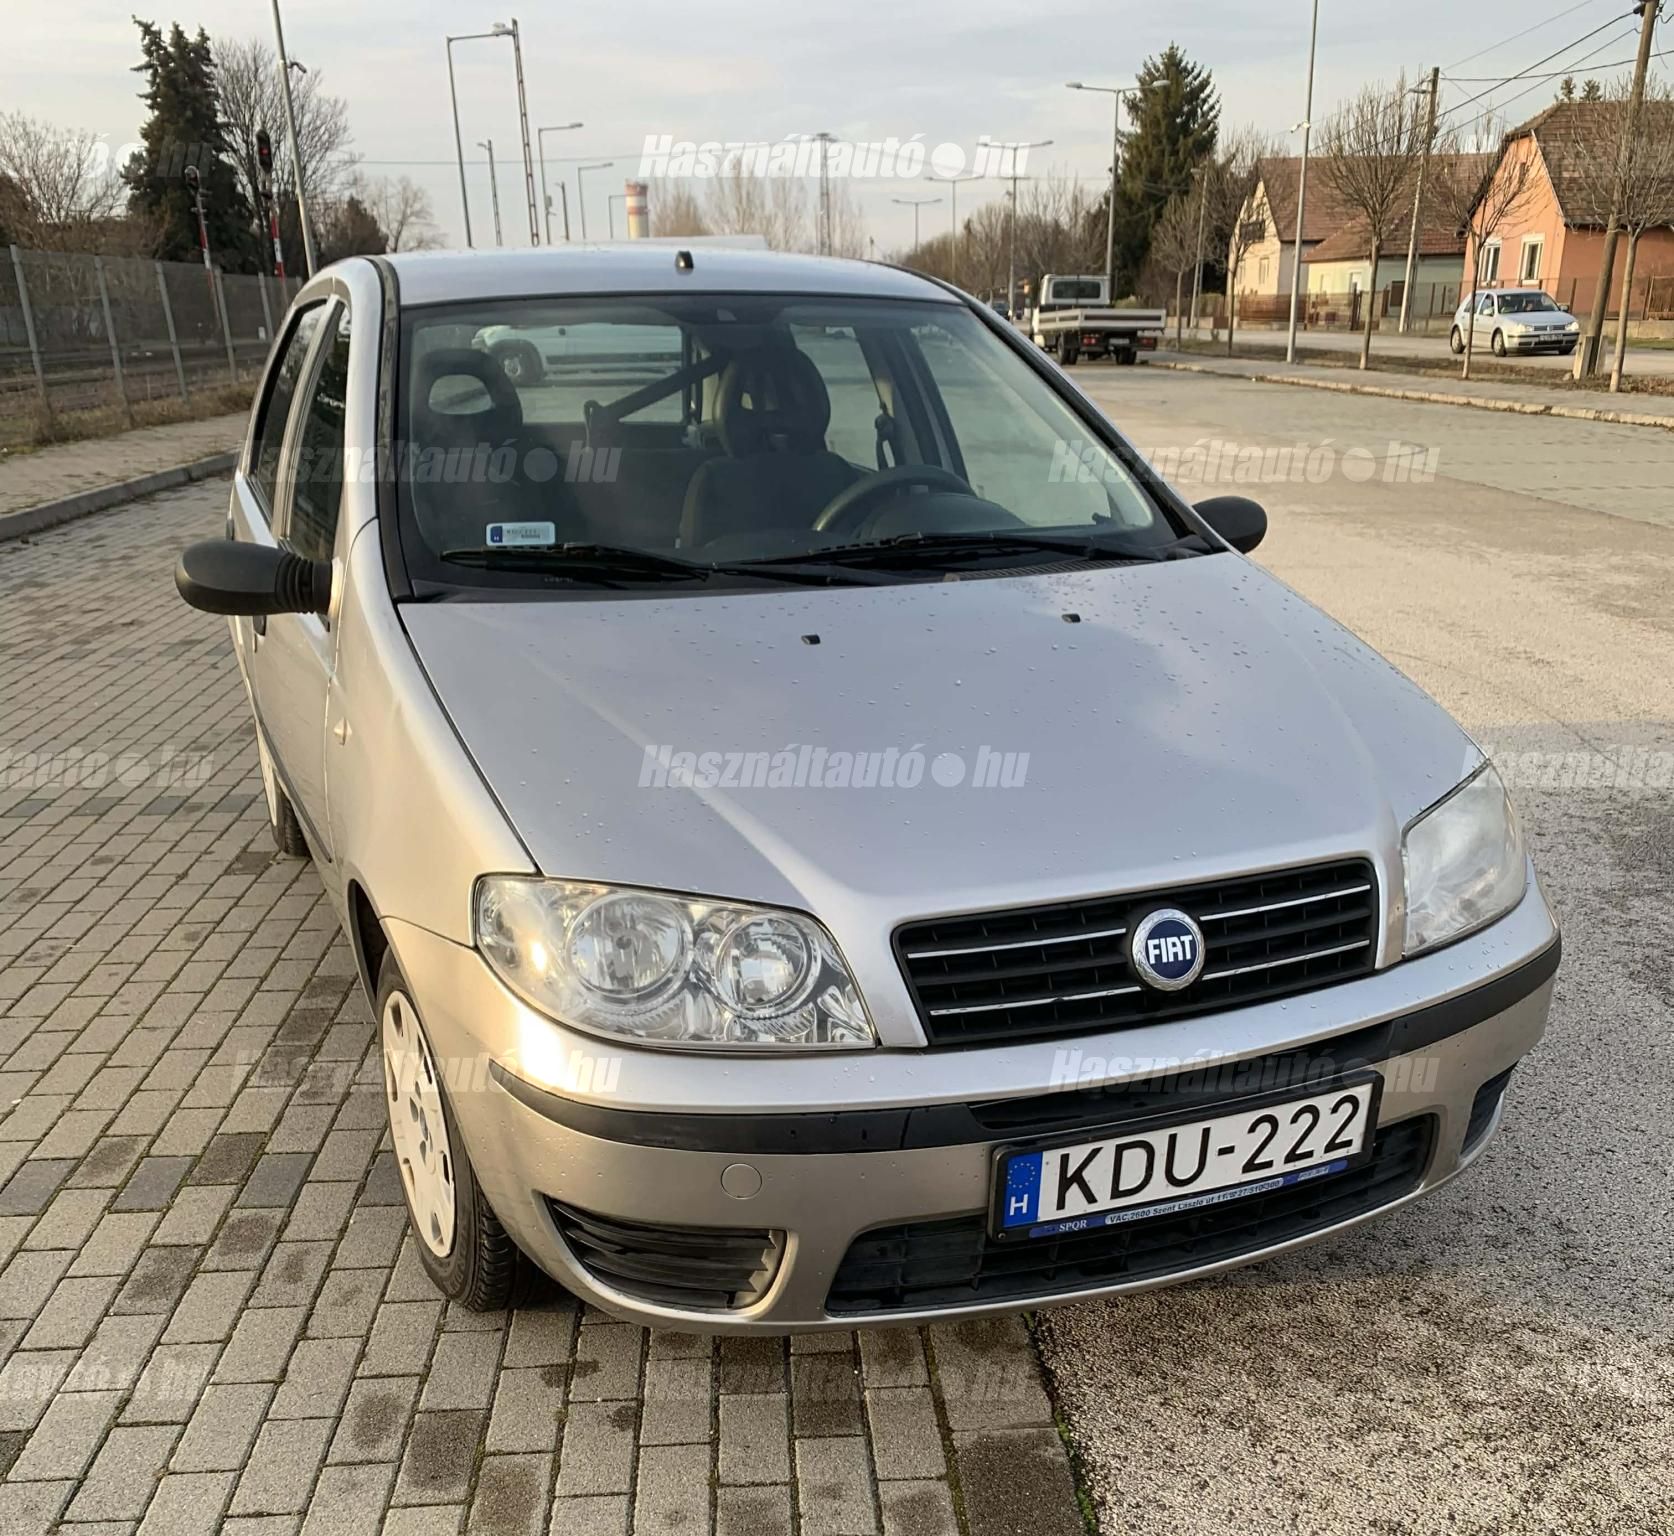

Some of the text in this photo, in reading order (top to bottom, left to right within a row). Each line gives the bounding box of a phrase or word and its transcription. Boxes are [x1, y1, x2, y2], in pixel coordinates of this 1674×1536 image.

[1147, 934, 1193, 965] FIAT
[1009, 1094, 1361, 1216] H KDU-222
[1058, 1219, 1088, 1232] SPQR
